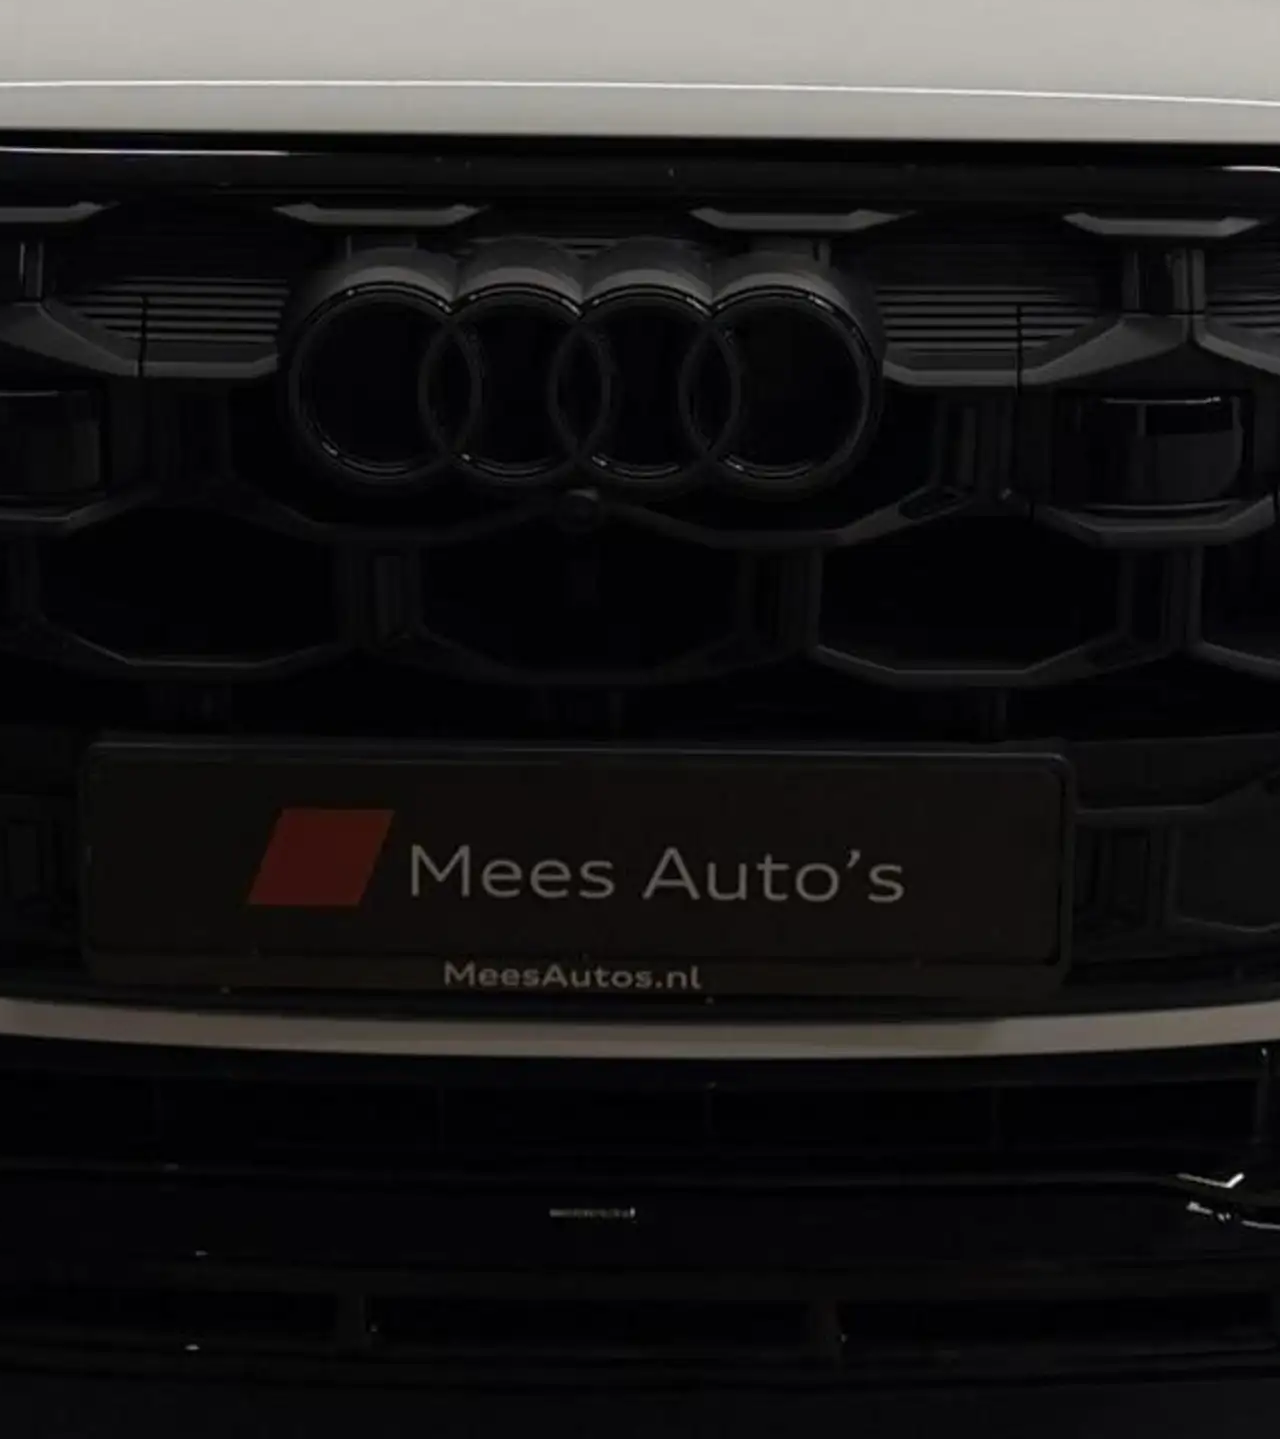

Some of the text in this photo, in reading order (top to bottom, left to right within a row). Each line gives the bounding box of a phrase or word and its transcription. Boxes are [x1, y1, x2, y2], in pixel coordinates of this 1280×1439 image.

[410, 844, 905, 903] Mees Auto's
[443, 961, 702, 990] MeesAutos.nl
